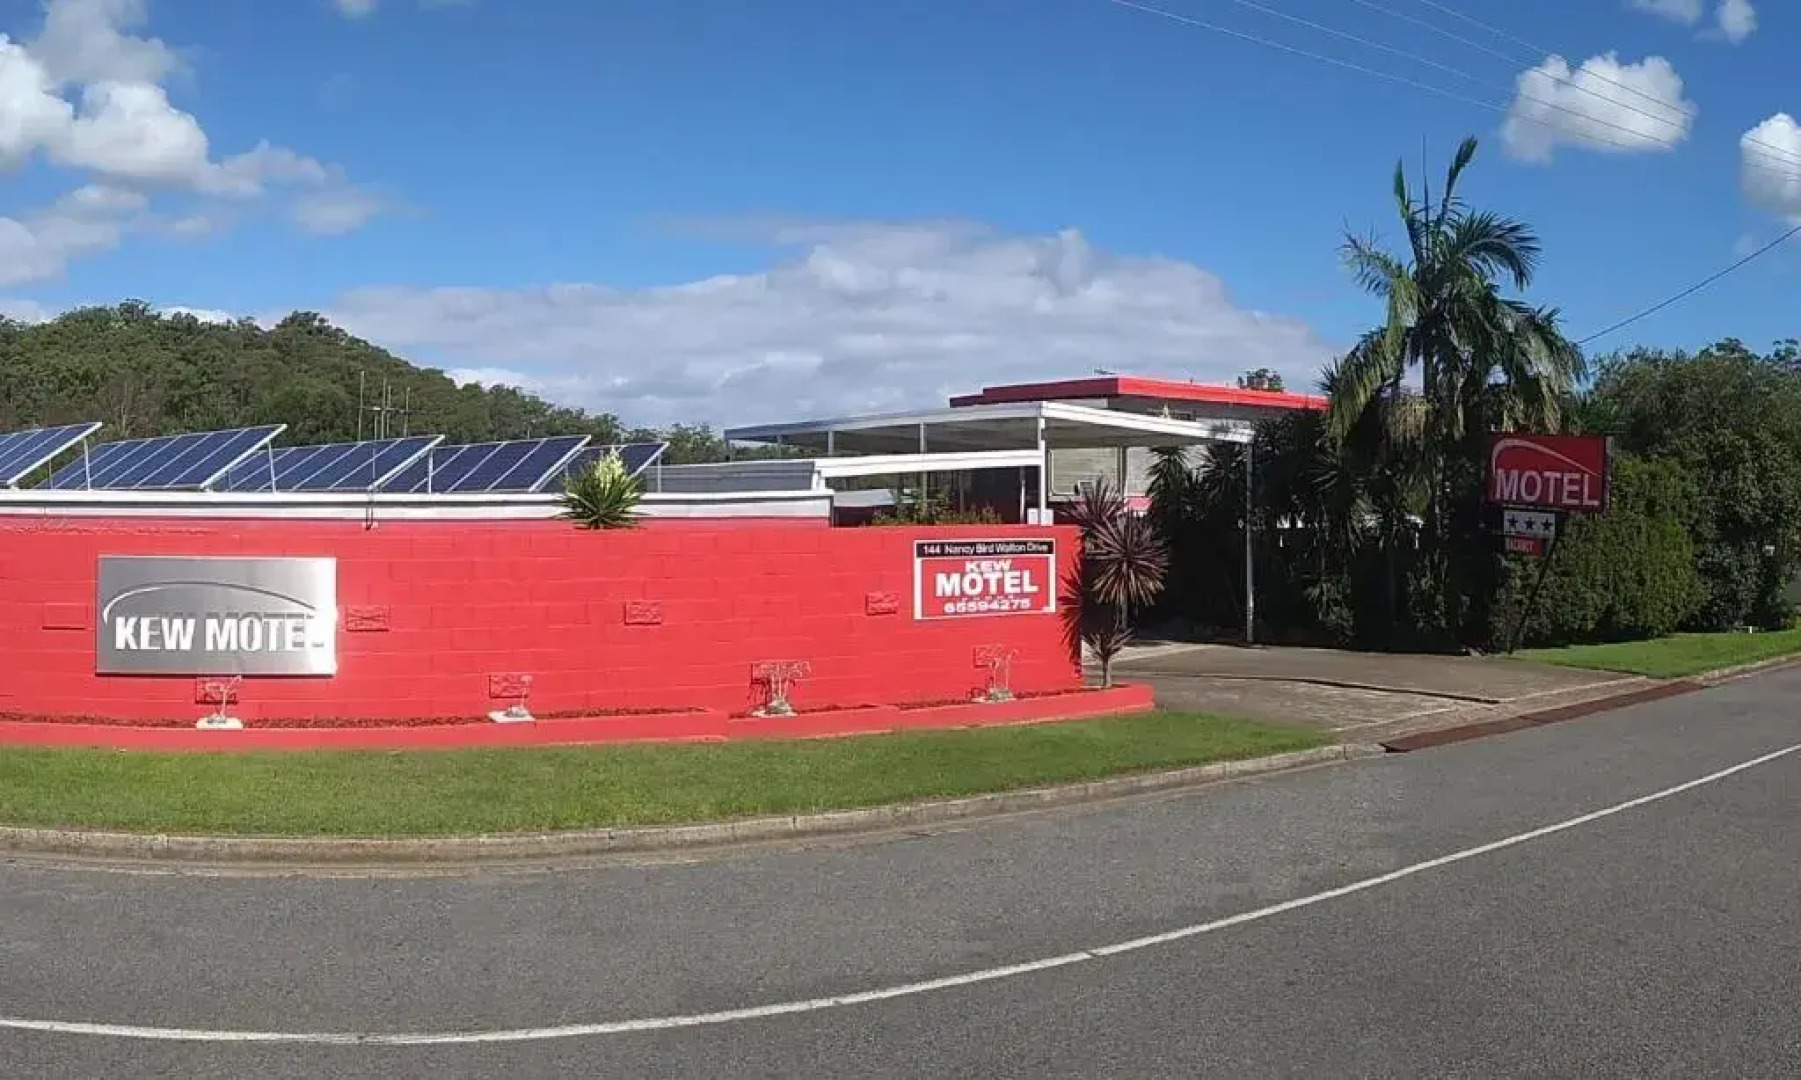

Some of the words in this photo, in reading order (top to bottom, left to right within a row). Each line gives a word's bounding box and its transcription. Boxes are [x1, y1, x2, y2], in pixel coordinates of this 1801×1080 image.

[1495, 469, 1600, 506] MOTEL
[923, 545, 941, 555] 144
[945, 544, 974, 554] Nancy
[976, 543, 994, 554] Bird
[1026, 541, 1049, 552] Drive
[965, 560, 1012, 573] KEW
[935, 570, 1039, 597] MOTEL
[115, 616, 196, 651] KEW
